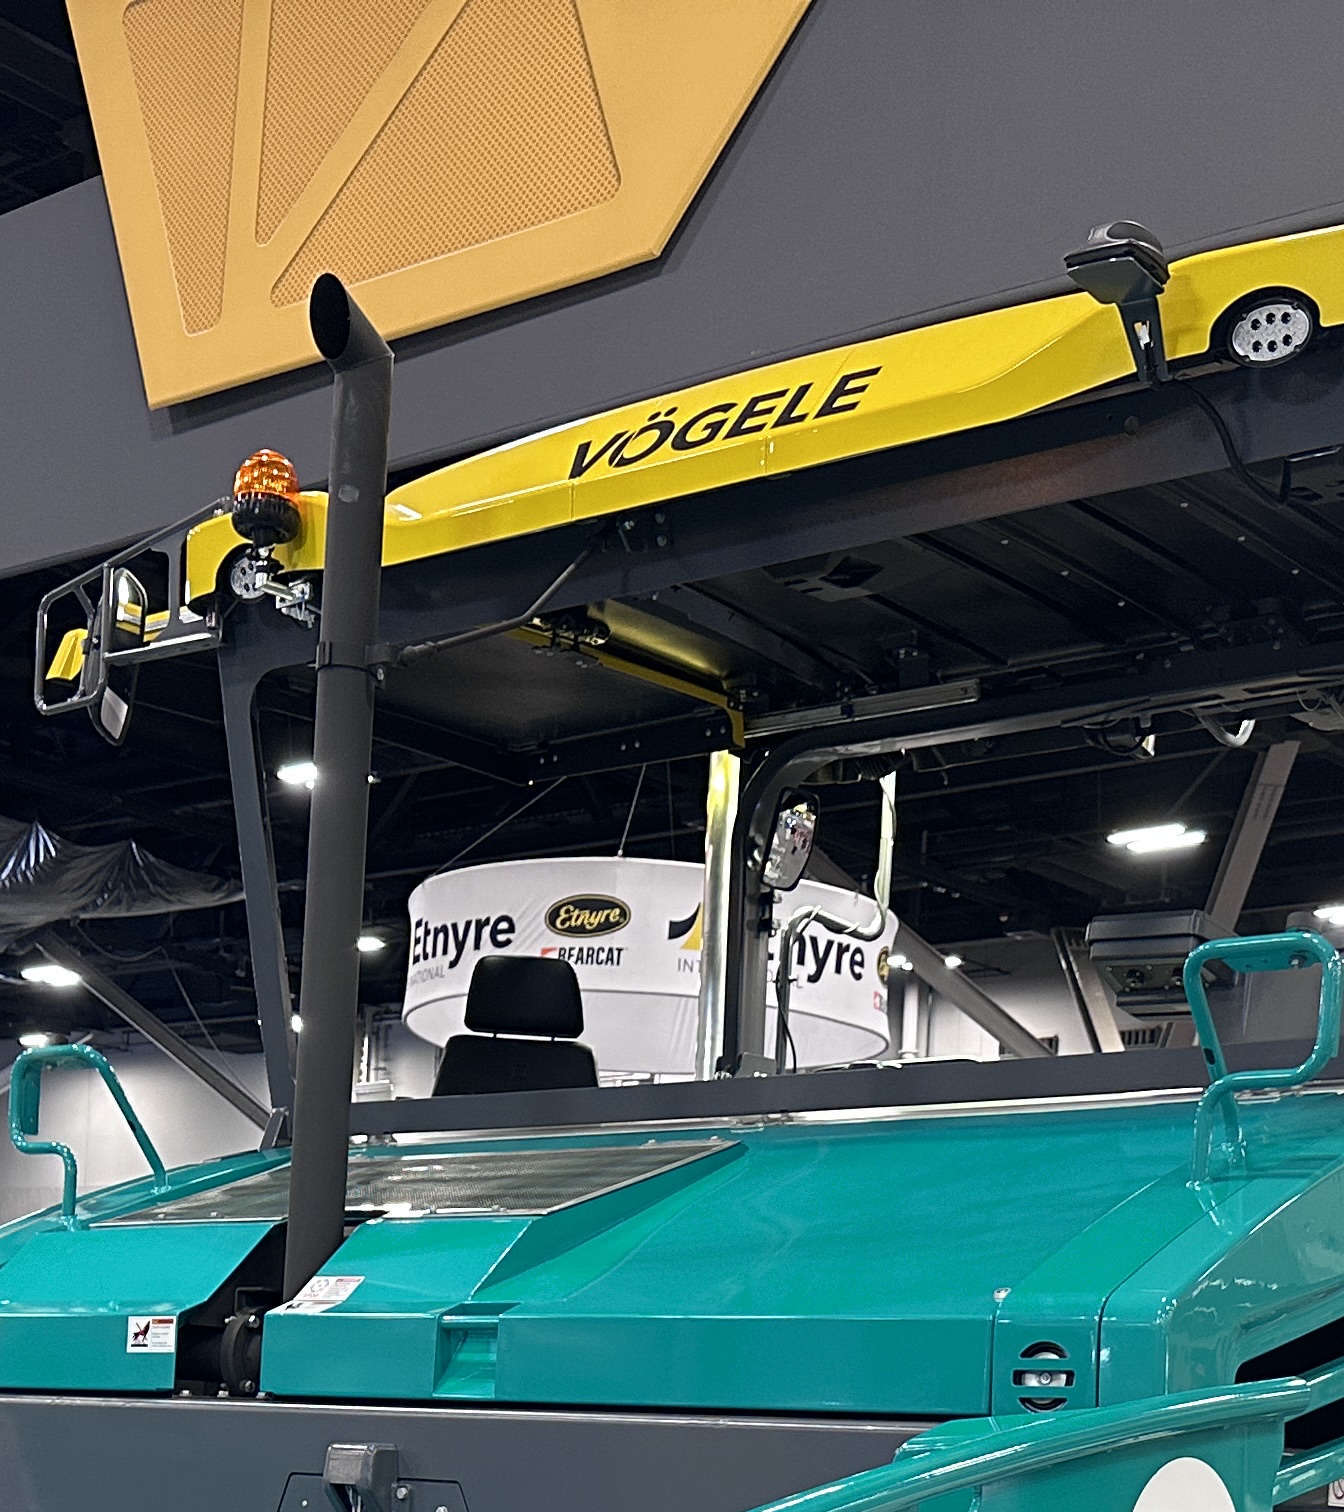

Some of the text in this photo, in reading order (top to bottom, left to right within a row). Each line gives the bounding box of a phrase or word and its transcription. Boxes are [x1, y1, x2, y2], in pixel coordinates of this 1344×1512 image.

[568, 366, 881, 480] VÖGELE
[412, 914, 515, 969] Etnyre
[555, 904, 621, 930] Etnyre
